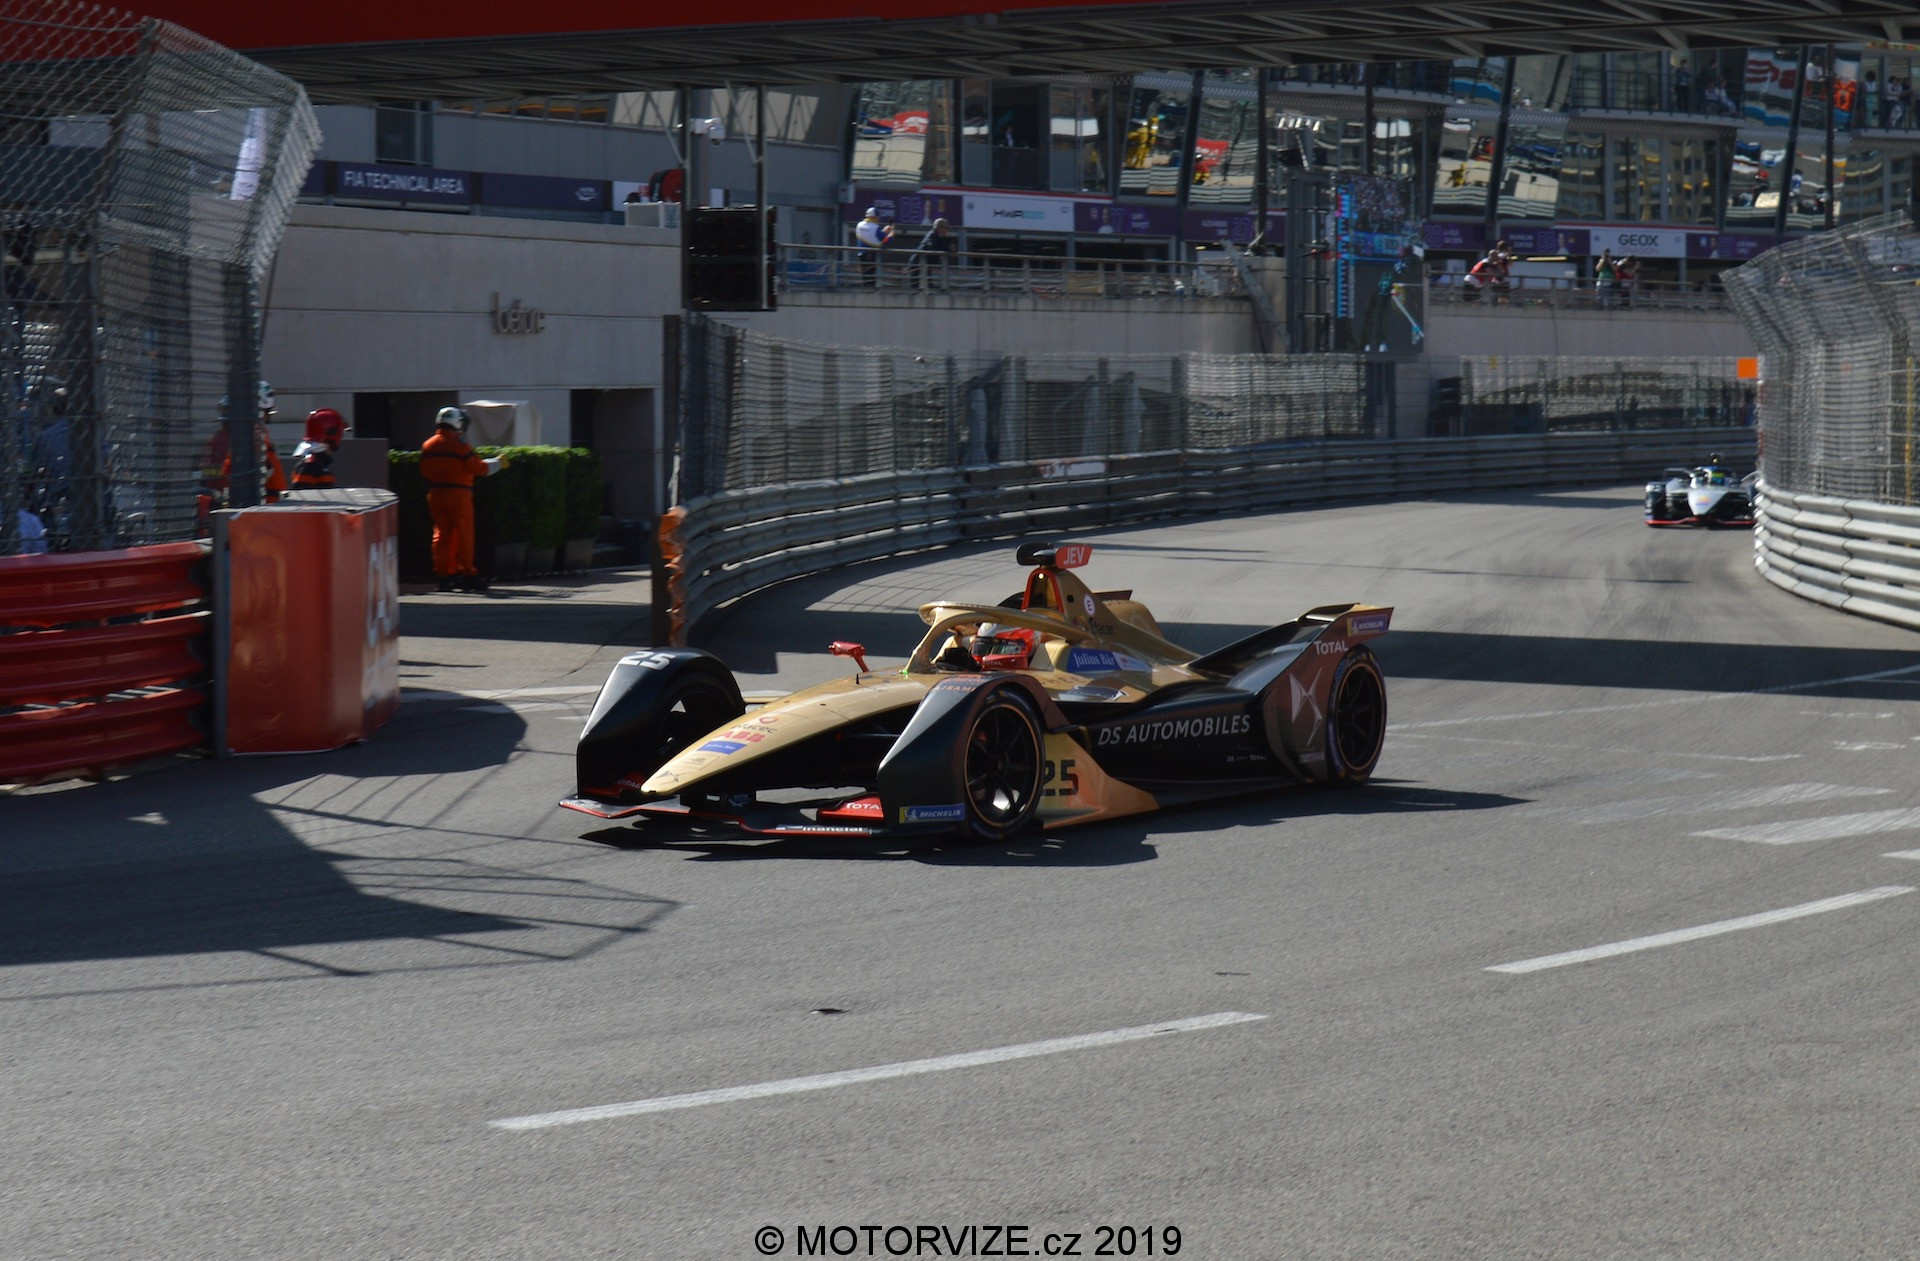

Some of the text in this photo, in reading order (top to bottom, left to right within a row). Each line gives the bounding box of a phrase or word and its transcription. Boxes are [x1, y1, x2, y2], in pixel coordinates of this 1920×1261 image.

[343, 170, 465, 194] FIA TECHNICAL AREA
[1618, 233, 1659, 247] GEOX
[1063, 546, 1086, 565] JEV
[1358, 620, 1385, 630] MICHELIN
[1313, 640, 1349, 655] TOTAL
[618, 650, 677, 671] 25
[1073, 652, 1100, 668] Julius
[714, 730, 766, 743] ABB
[1098, 714, 1251, 746] DS AUTOMOBILES
[1042, 759, 1079, 796] 25
[845, 802, 881, 811] TOTA
[919, 808, 962, 818] MICHELIN
